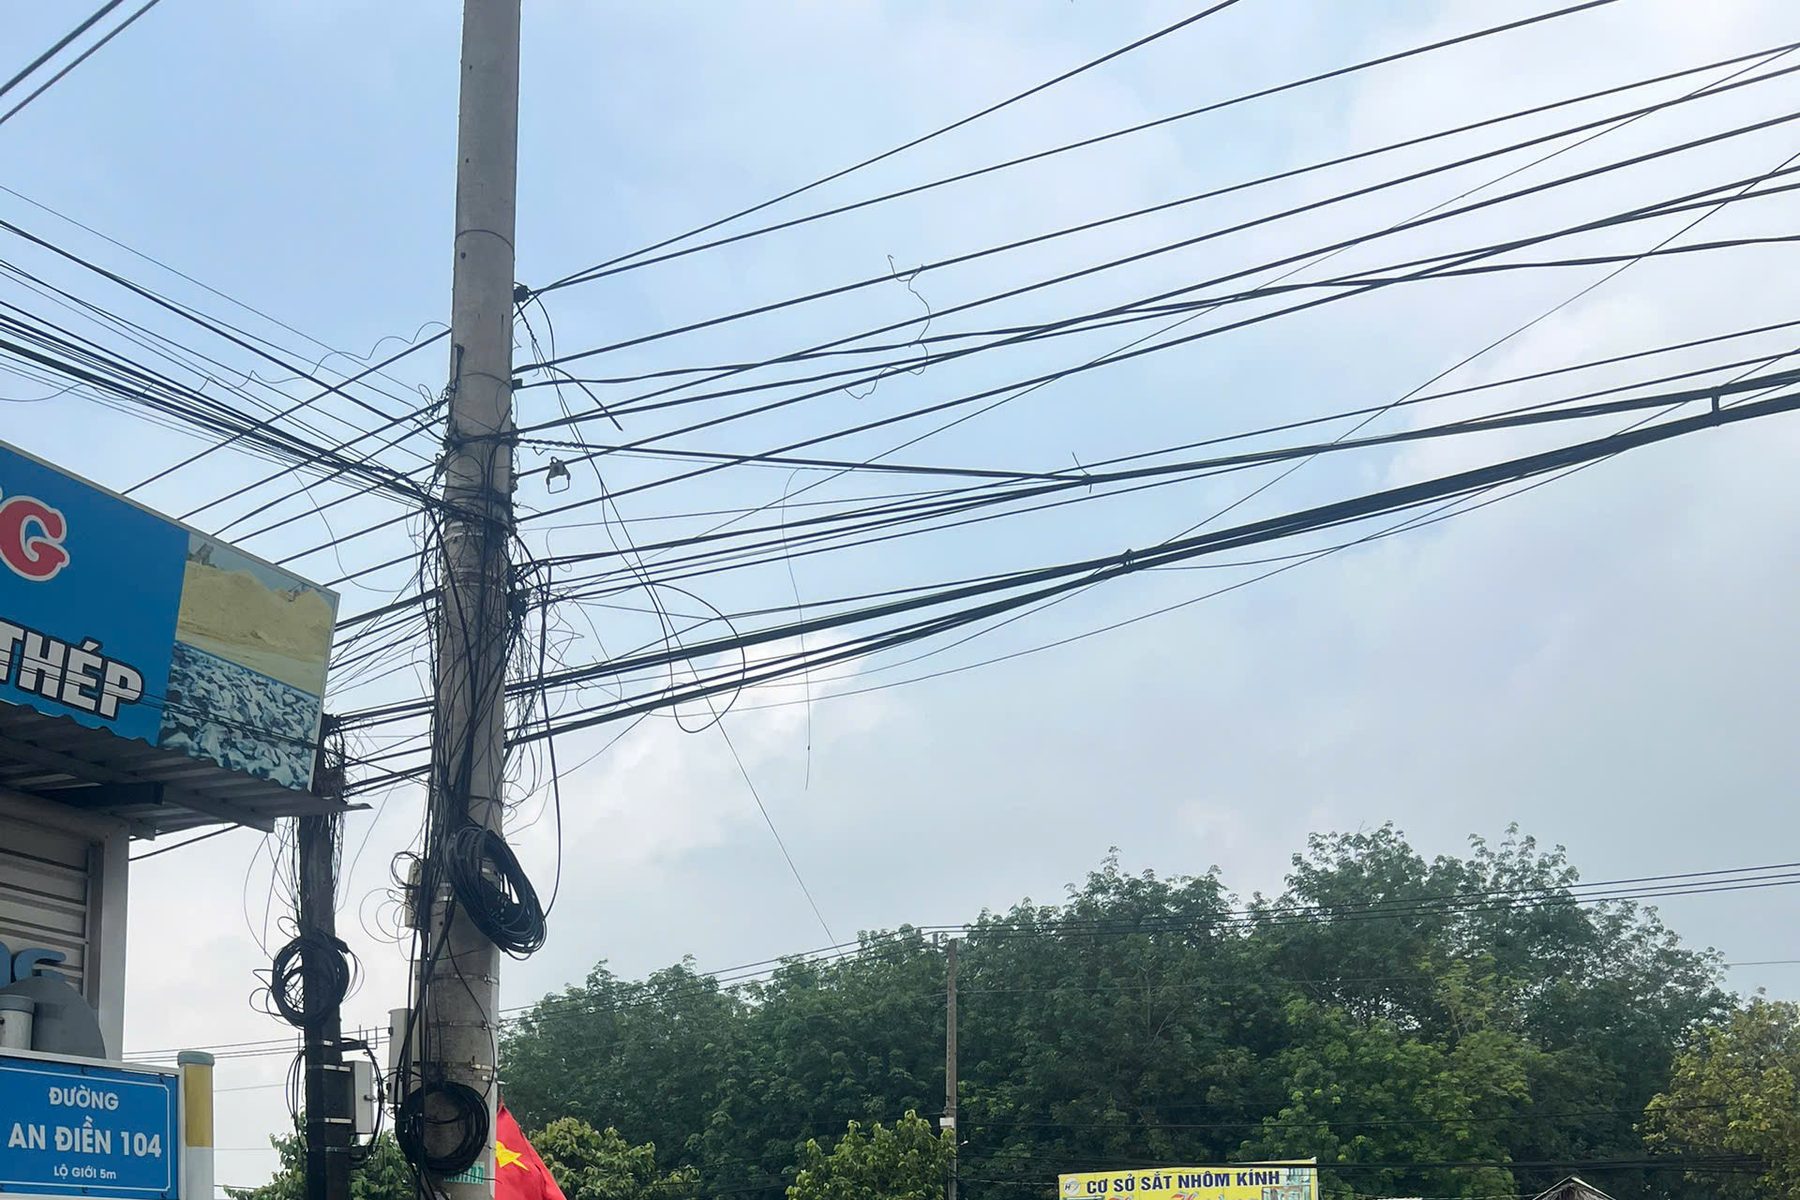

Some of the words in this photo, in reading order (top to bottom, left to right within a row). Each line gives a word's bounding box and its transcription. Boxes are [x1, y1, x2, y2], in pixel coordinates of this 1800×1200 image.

[49, 1084, 119, 1111] ĐƯỜNG
[8, 1122, 46, 1150] AN
[54, 1115, 111, 1155] ĐIỀN
[120, 1131, 162, 1158] 104
[53, 1163, 68, 1180] LỘ
[72, 1164, 97, 1179] GIỚI
[100, 1169, 117, 1180] 5m
[1087, 1178, 1108, 1194] CƠ
[1113, 1173, 1135, 1192] SỞ
[1141, 1171, 1172, 1190] SẮT
[1178, 1171, 1230, 1189] NHÔM
[1236, 1169, 1280, 1186] KÍNH
